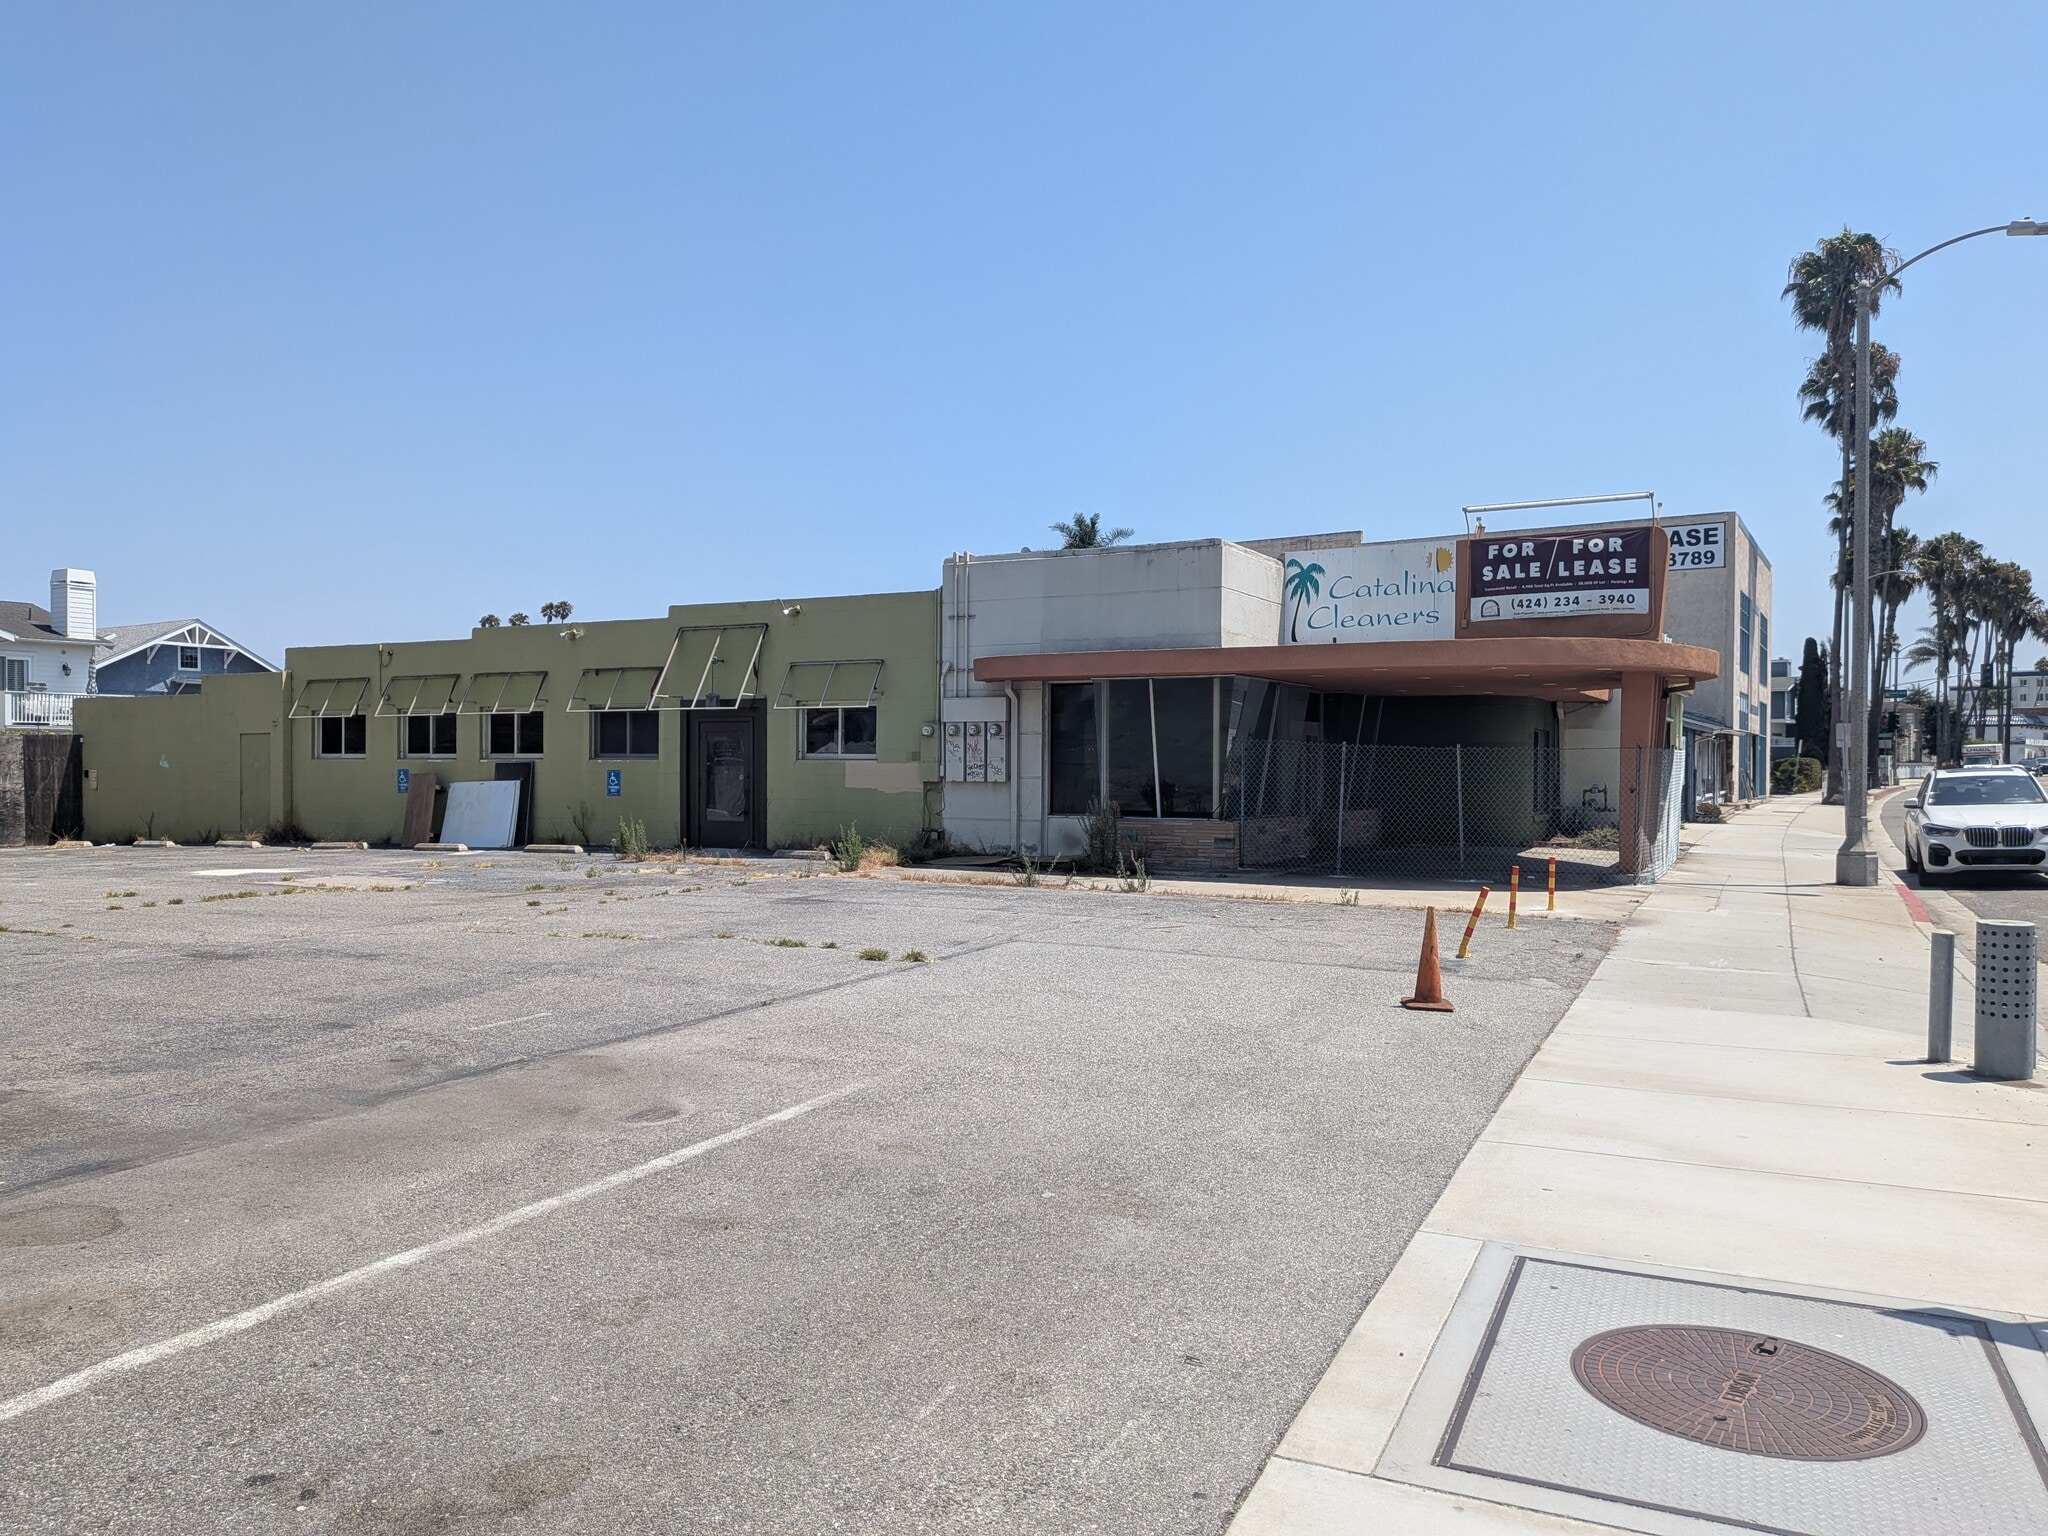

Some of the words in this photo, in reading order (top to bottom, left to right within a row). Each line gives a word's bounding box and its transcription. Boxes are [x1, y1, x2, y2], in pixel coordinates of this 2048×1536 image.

[1572, 537, 1624, 554] FOR
[1670, 527, 1719, 548] ASE
[1488, 542, 1536, 560] FOR
[1482, 562, 1542, 582] SALE
[1558, 558, 1638, 577] LEASE
[1328, 570, 1456, 600] Catalina
[1511, 596, 1548, 610] (424)
[1554, 596, 1580, 607] 234
[1598, 594, 1636, 605] 3940
[1307, 604, 1440, 630] Cleaners
[1721, 1372, 1758, 1404] EDISON
